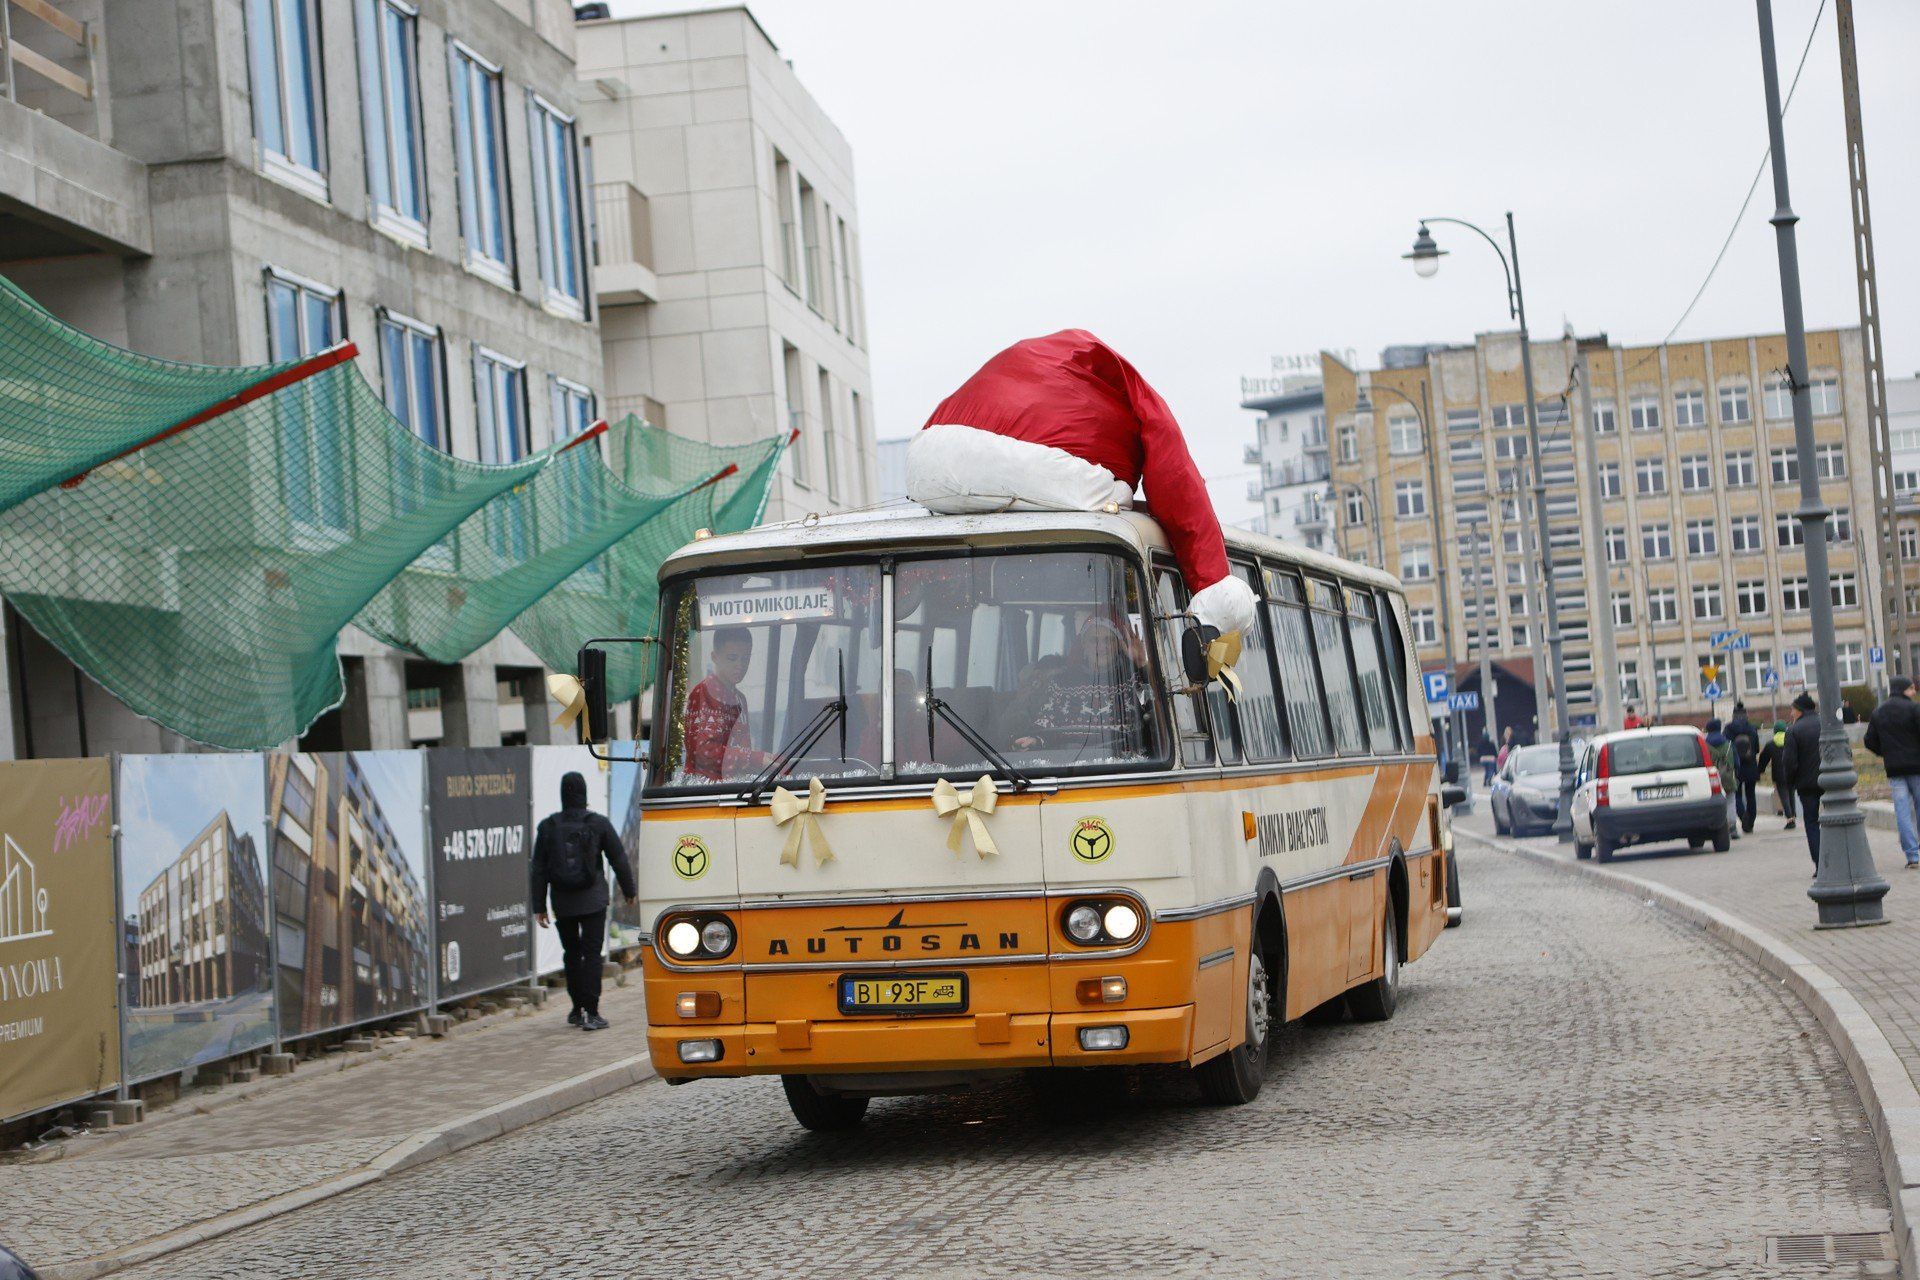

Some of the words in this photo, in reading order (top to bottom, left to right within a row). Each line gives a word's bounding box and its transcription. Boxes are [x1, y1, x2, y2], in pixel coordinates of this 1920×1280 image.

[1429, 674, 1447, 699] P
[1450, 693, 1478, 708] TAXI
[1080, 819, 1101, 832] PKS
[1257, 814, 1286, 857] KMKM
[443, 830, 465, 861] +48
[466, 828, 486, 859] 578
[487, 826, 504, 857] 977
[506, 824, 524, 854] 067
[768, 932, 1019, 956] AUTOSAN
[858, 983, 880, 1003] BI
[891, 982, 928, 1003] 93F
